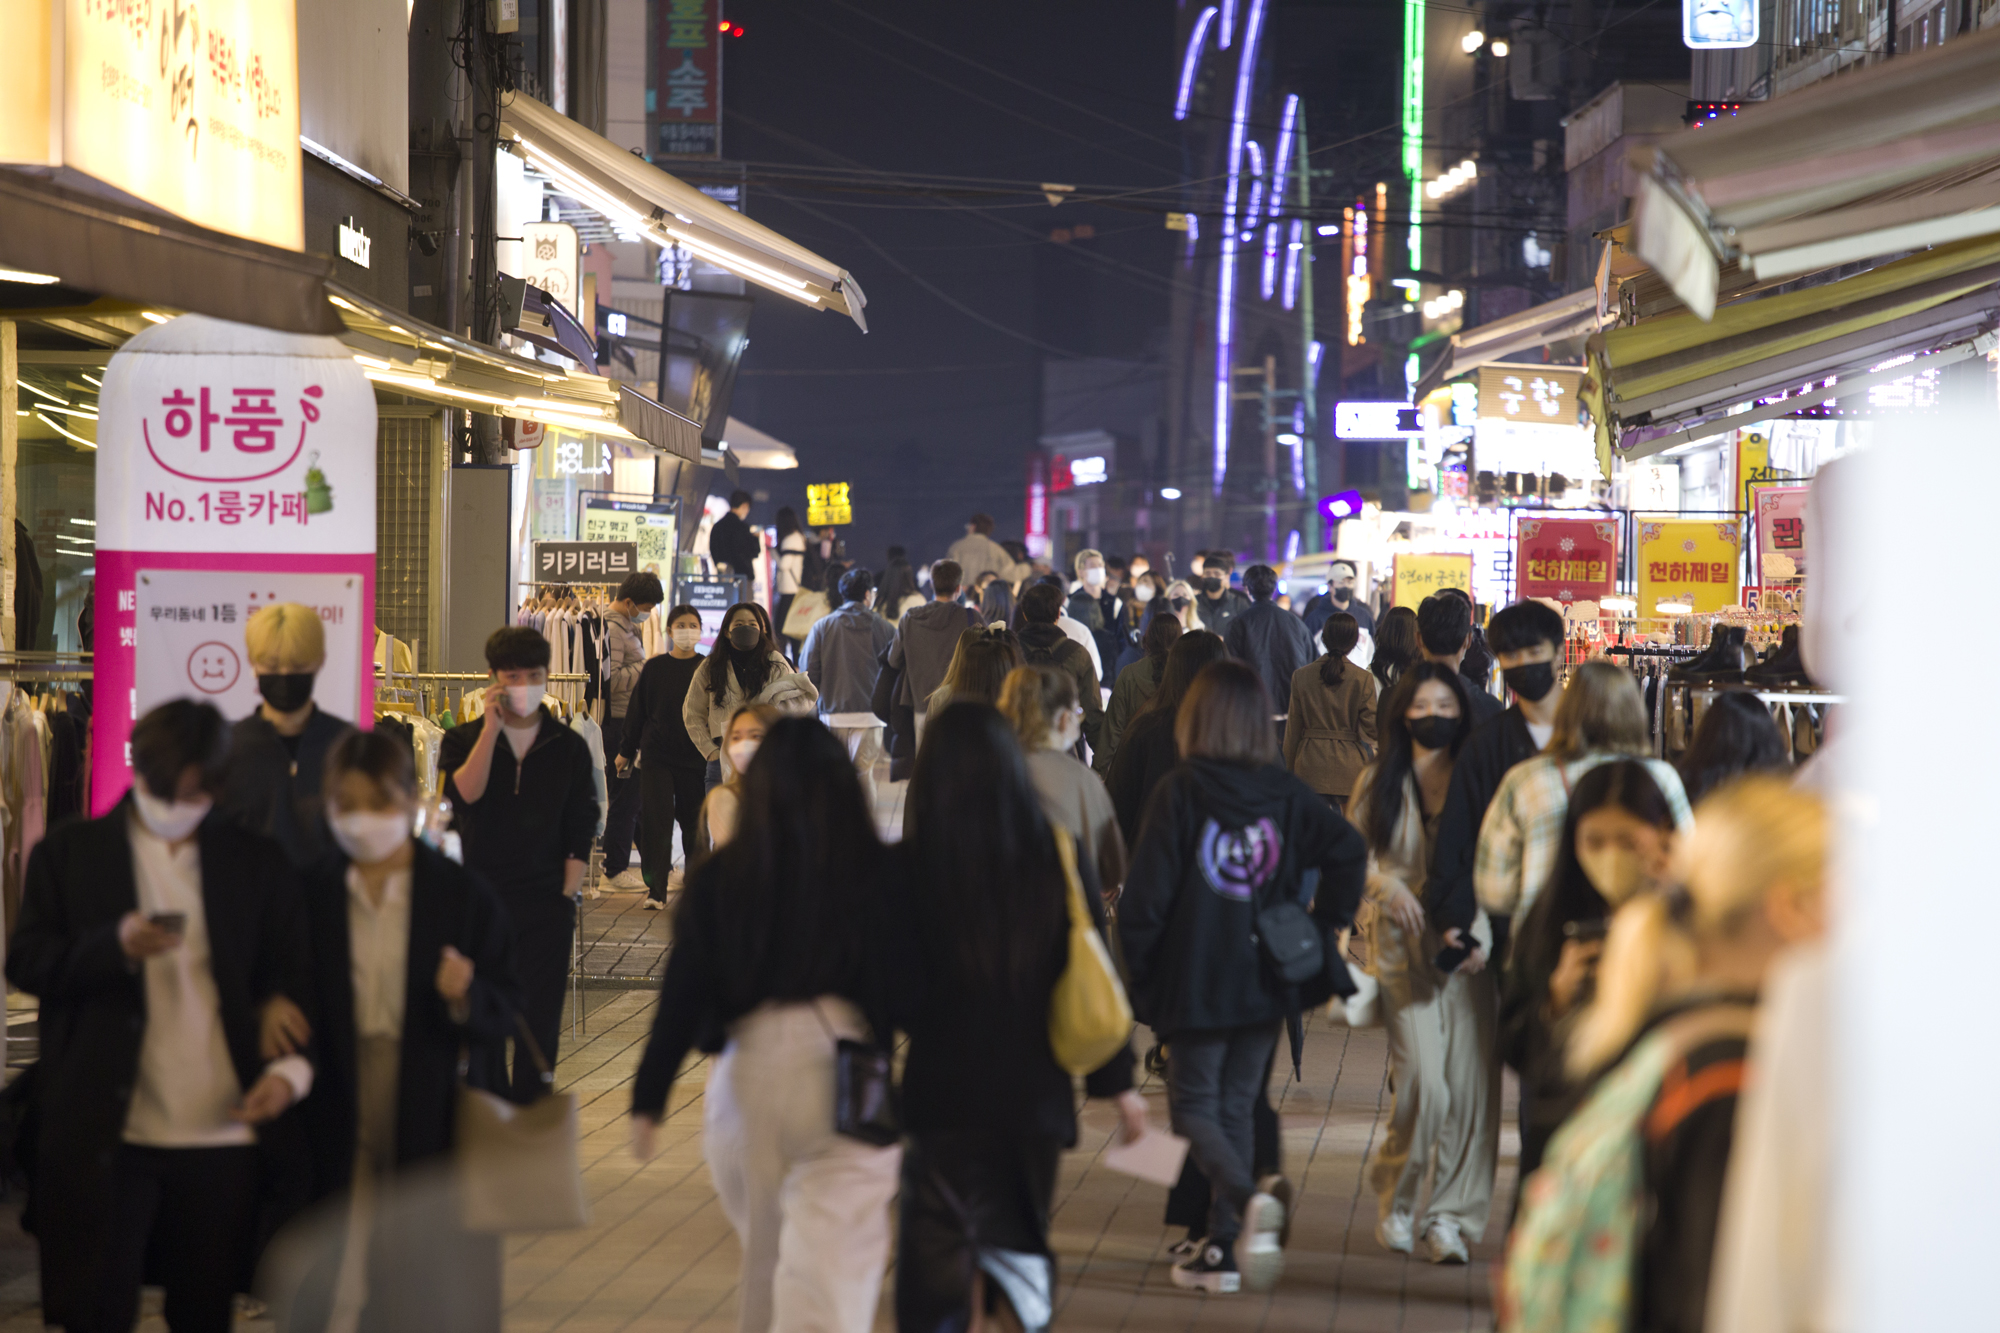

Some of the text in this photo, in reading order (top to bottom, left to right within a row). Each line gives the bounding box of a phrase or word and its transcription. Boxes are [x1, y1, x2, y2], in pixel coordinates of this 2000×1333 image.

[667, 59, 708, 117] 소주
[162, 386, 283, 454] 하품
[587, 520, 606, 531] 친구
[1772, 517, 1804, 549] 관
[542, 550, 630, 575] 키키러브
[1527, 559, 1607, 582] 천하제일
[1649, 561, 1729, 583] 천하제일
[212, 603, 237, 623] 1등
